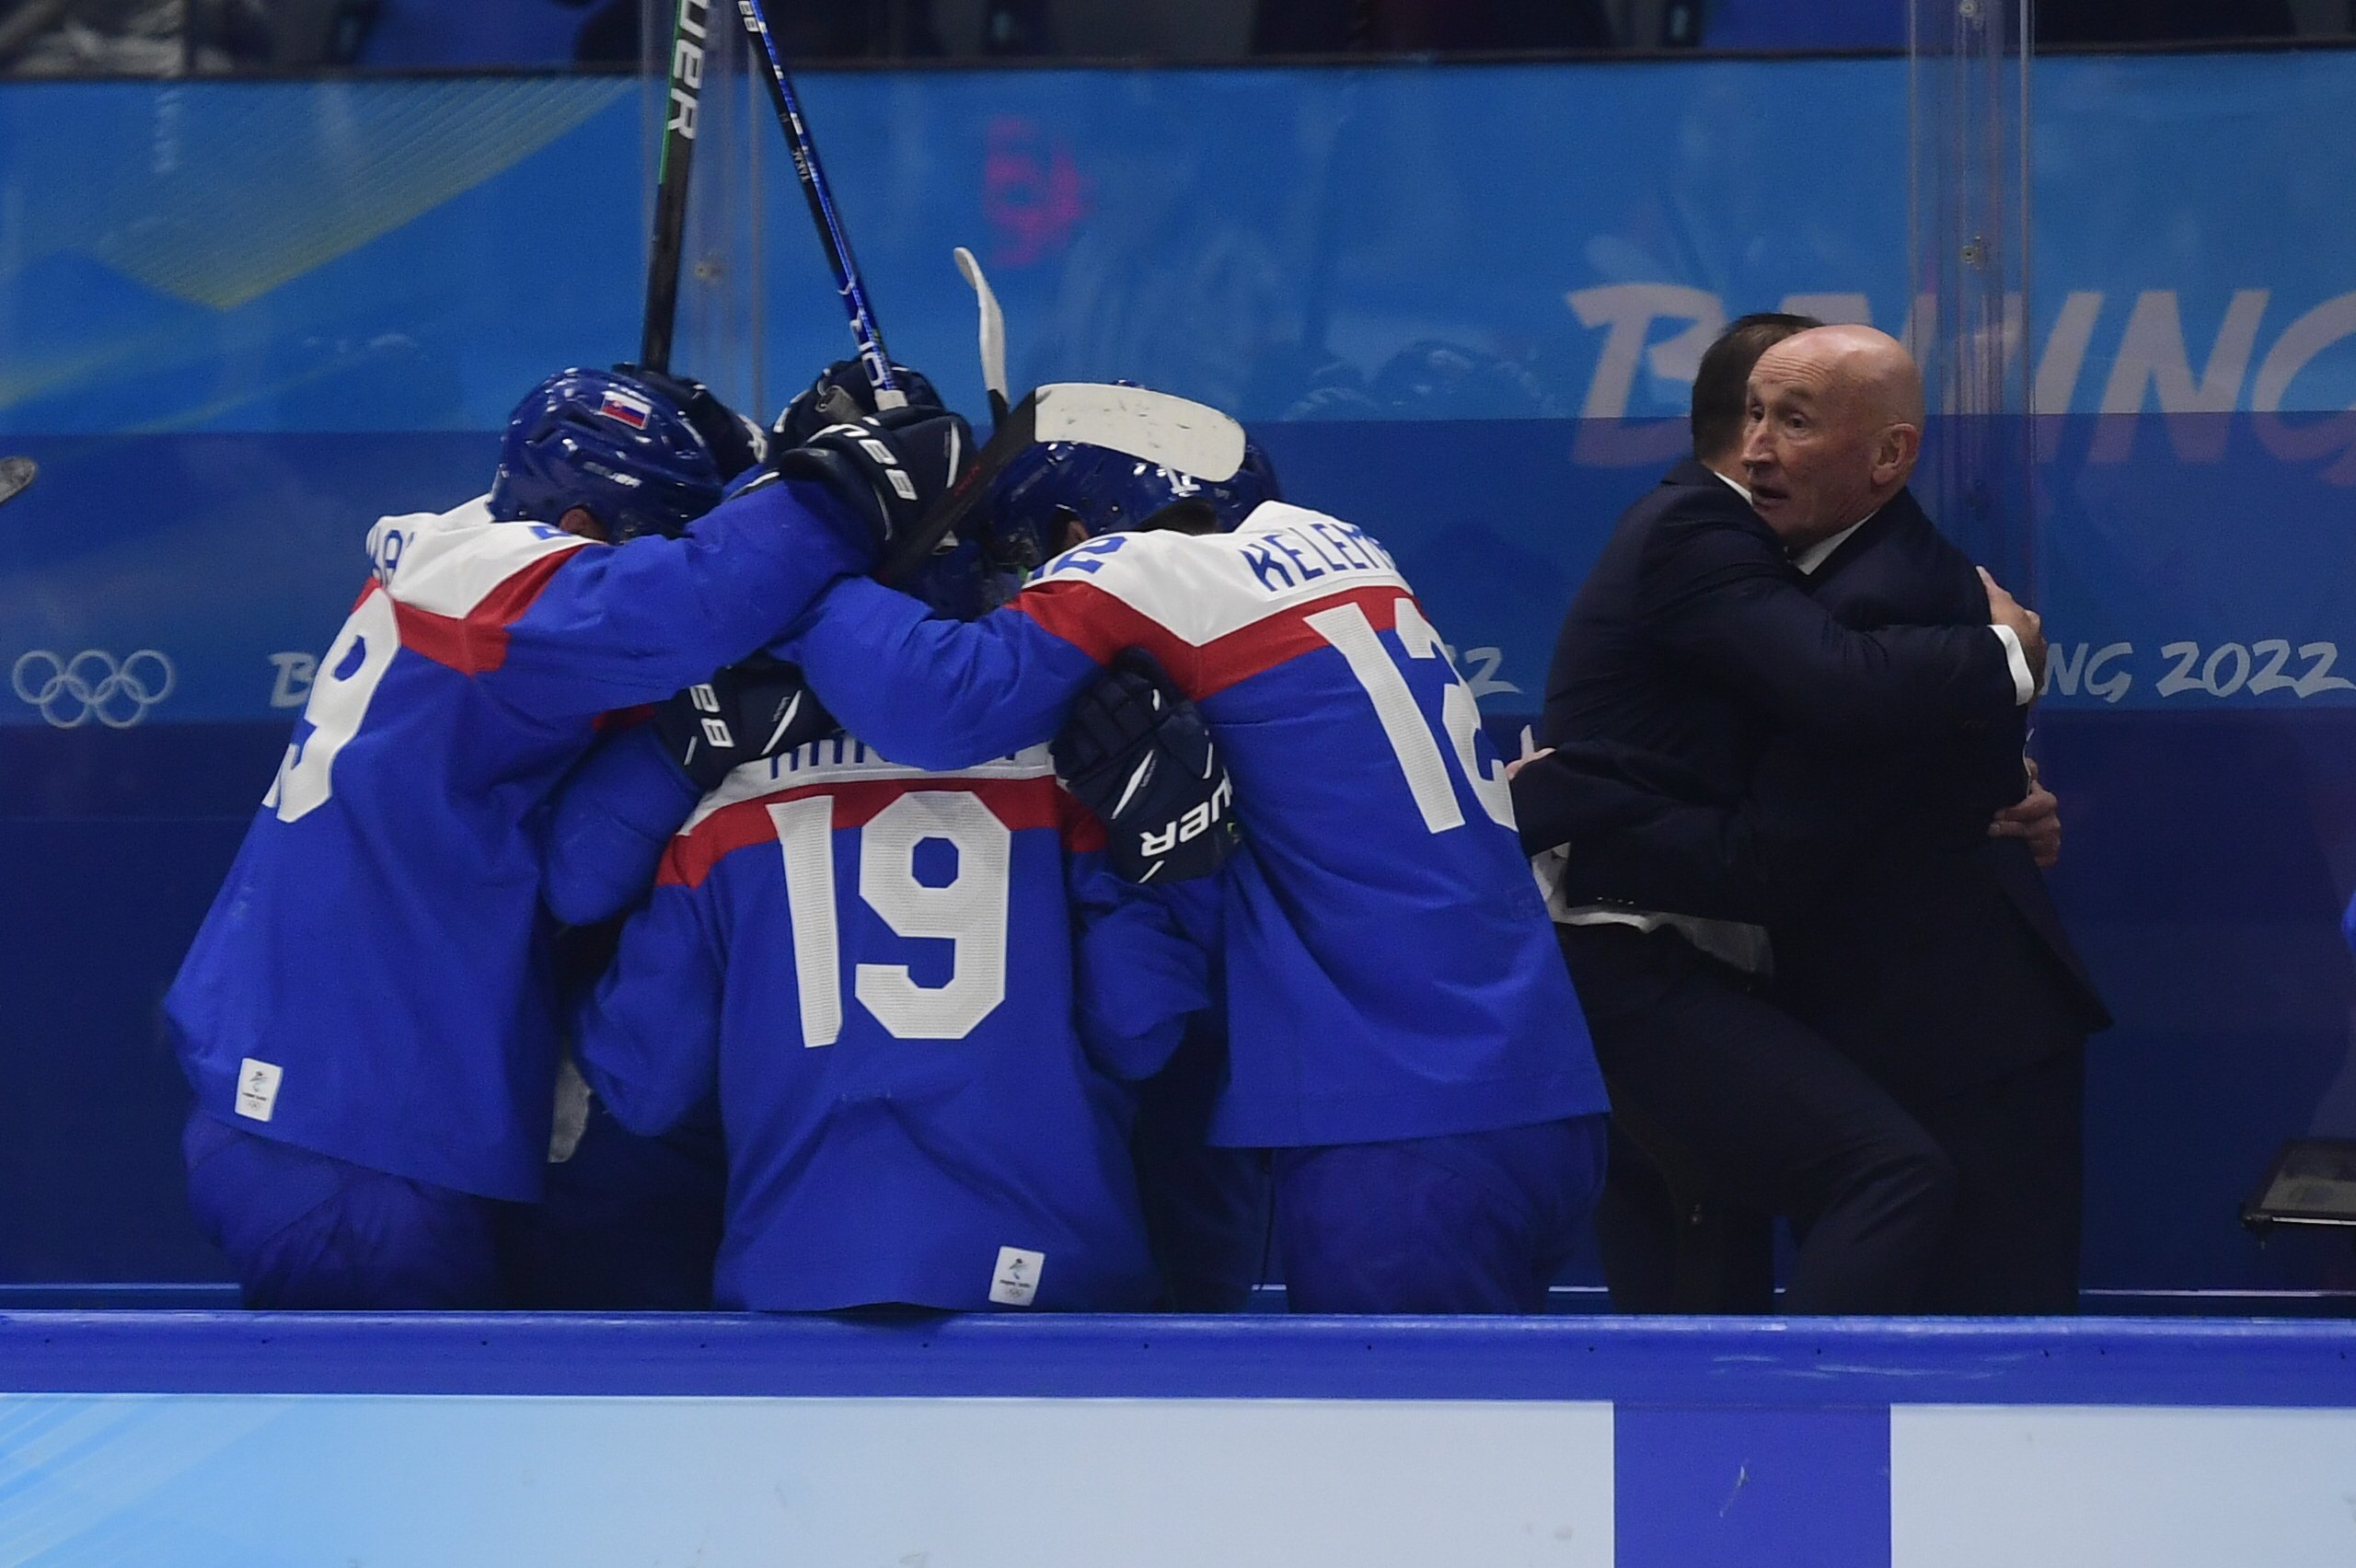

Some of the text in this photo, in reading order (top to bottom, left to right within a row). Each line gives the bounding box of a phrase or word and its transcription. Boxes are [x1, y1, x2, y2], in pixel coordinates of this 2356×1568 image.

[1564, 281, 2356, 485] BING
[1239, 519, 1397, 593] KELEM
[261, 586, 401, 823] 9
[1301, 597, 1519, 834] 12
[1447, 644, 1524, 699] 2
[2155, 639, 2356, 699] 2022
[766, 789, 1011, 1049] 19
